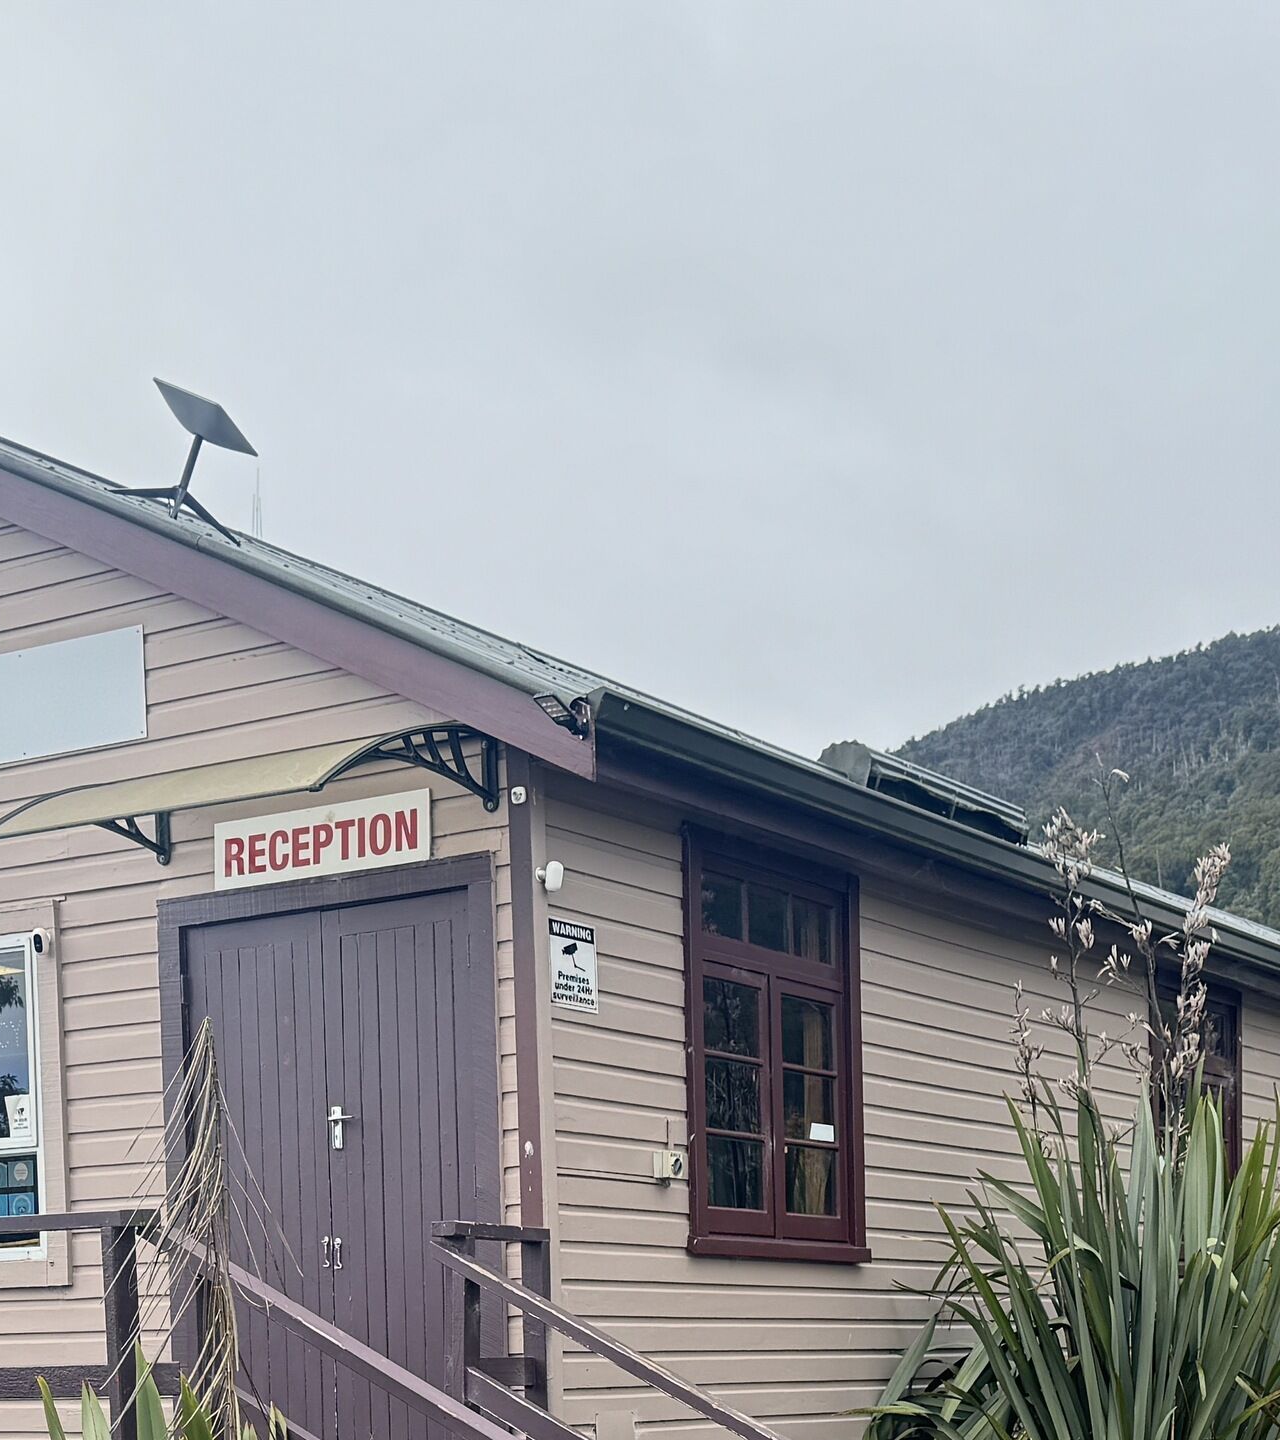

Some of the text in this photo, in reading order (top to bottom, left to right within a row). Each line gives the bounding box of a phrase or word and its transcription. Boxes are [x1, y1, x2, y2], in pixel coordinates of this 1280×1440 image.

[224, 808, 418, 877] RECEPTION
[551, 921, 592, 941] WARNING
[557, 970, 590, 985] Premises
[554, 982, 593, 996] under 24Hr
[552, 991, 595, 1006] surveillance
